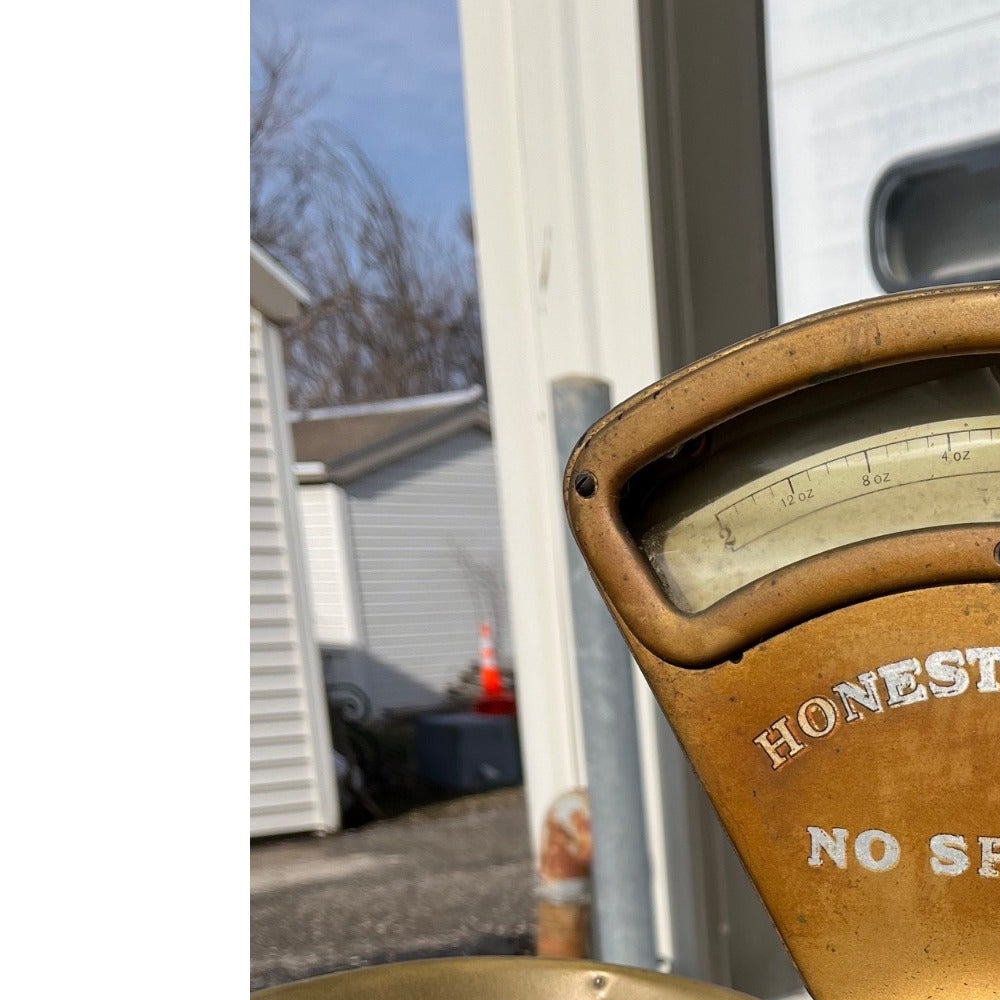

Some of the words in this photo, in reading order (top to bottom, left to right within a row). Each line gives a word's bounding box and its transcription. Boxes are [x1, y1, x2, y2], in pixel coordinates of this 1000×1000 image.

[941, 450, 950, 462] 4
[862, 474, 871, 487] 8
[781, 495, 796, 509] 12
[806, 826, 901, 873] NO
